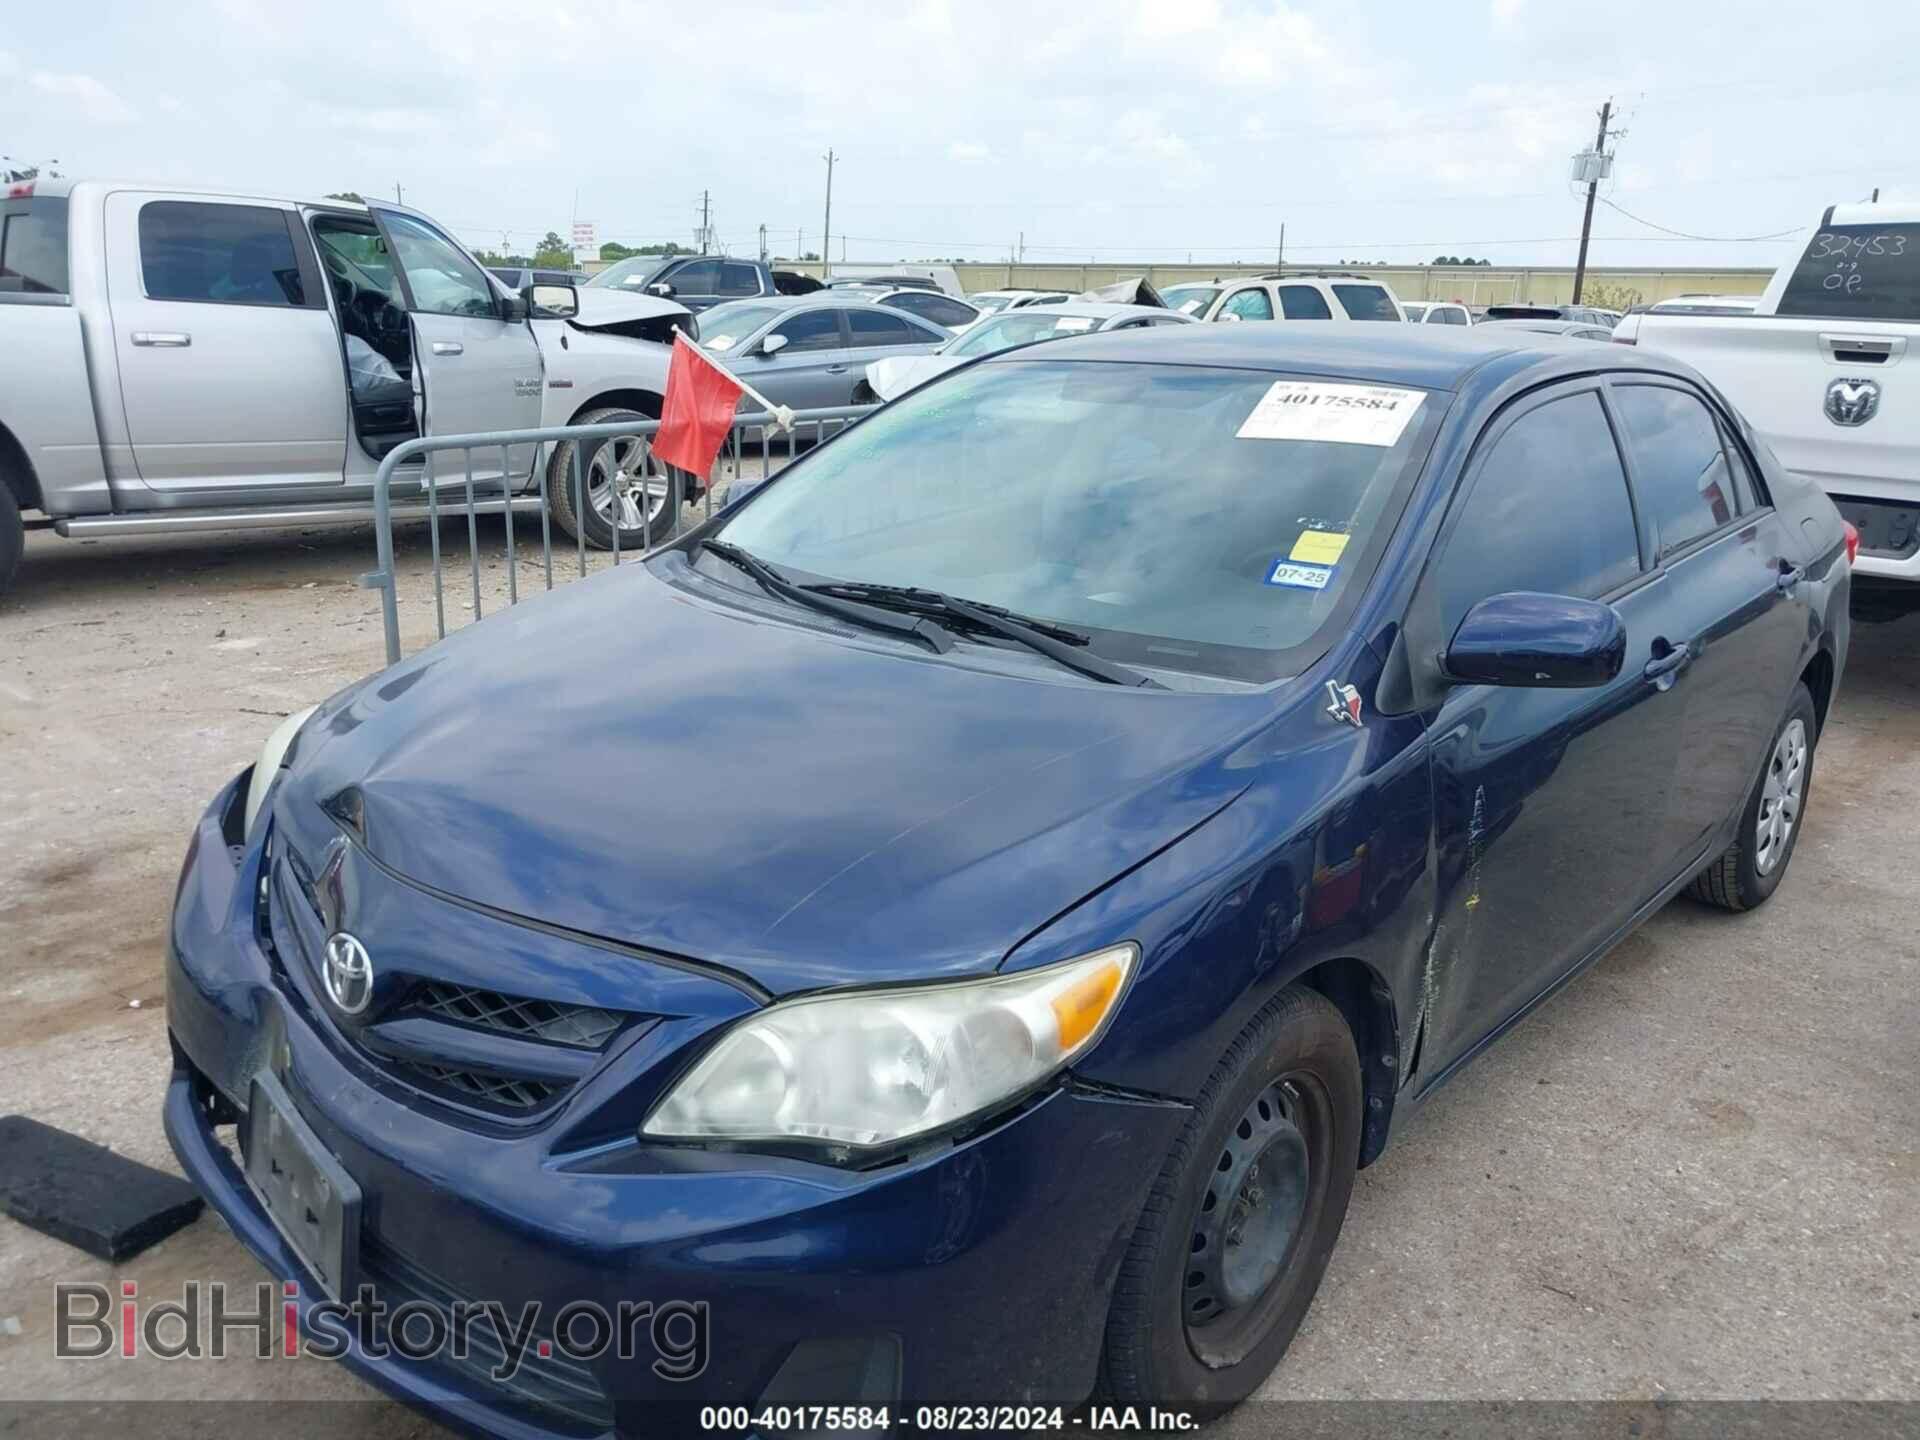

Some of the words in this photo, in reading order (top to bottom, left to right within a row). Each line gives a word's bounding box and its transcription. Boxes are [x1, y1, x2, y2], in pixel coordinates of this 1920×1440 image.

[1811, 233, 1906, 258] 32453
[1277, 393, 1399, 411] 40175584
[1276, 567, 1327, 583] 07-25
